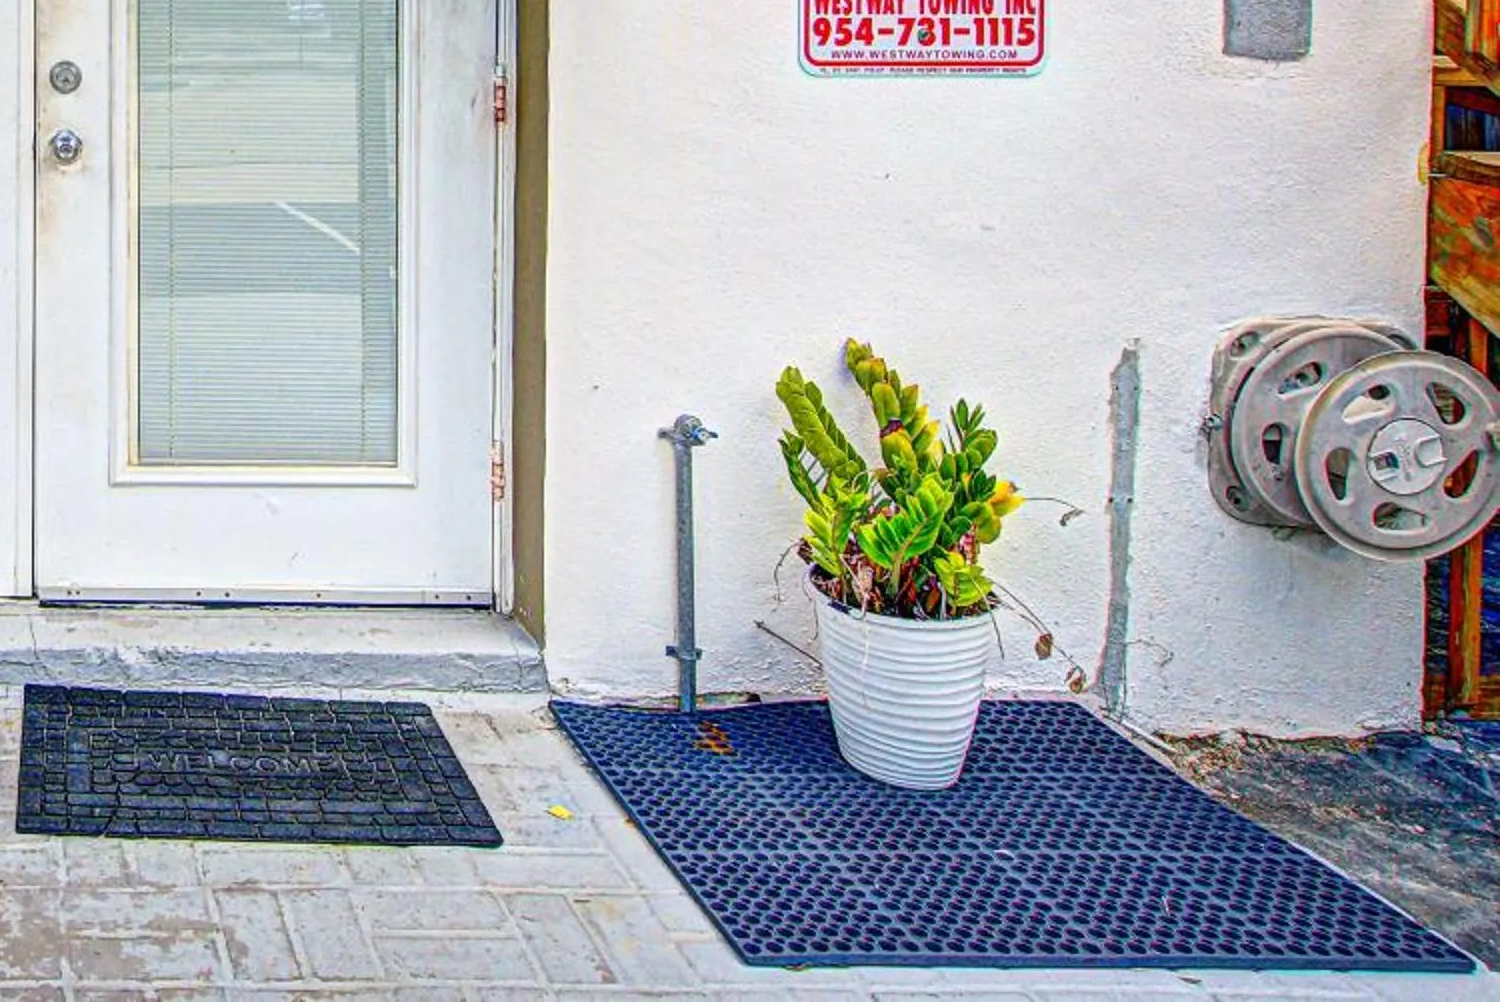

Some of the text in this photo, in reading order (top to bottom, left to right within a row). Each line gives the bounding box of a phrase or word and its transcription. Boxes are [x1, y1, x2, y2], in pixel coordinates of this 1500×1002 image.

[813, 17, 1036, 47] 954-731-1115
[831, 49, 1018, 60] WWW.WESTWAYTOWING.COM
[148, 753, 336, 775] WELCOME
